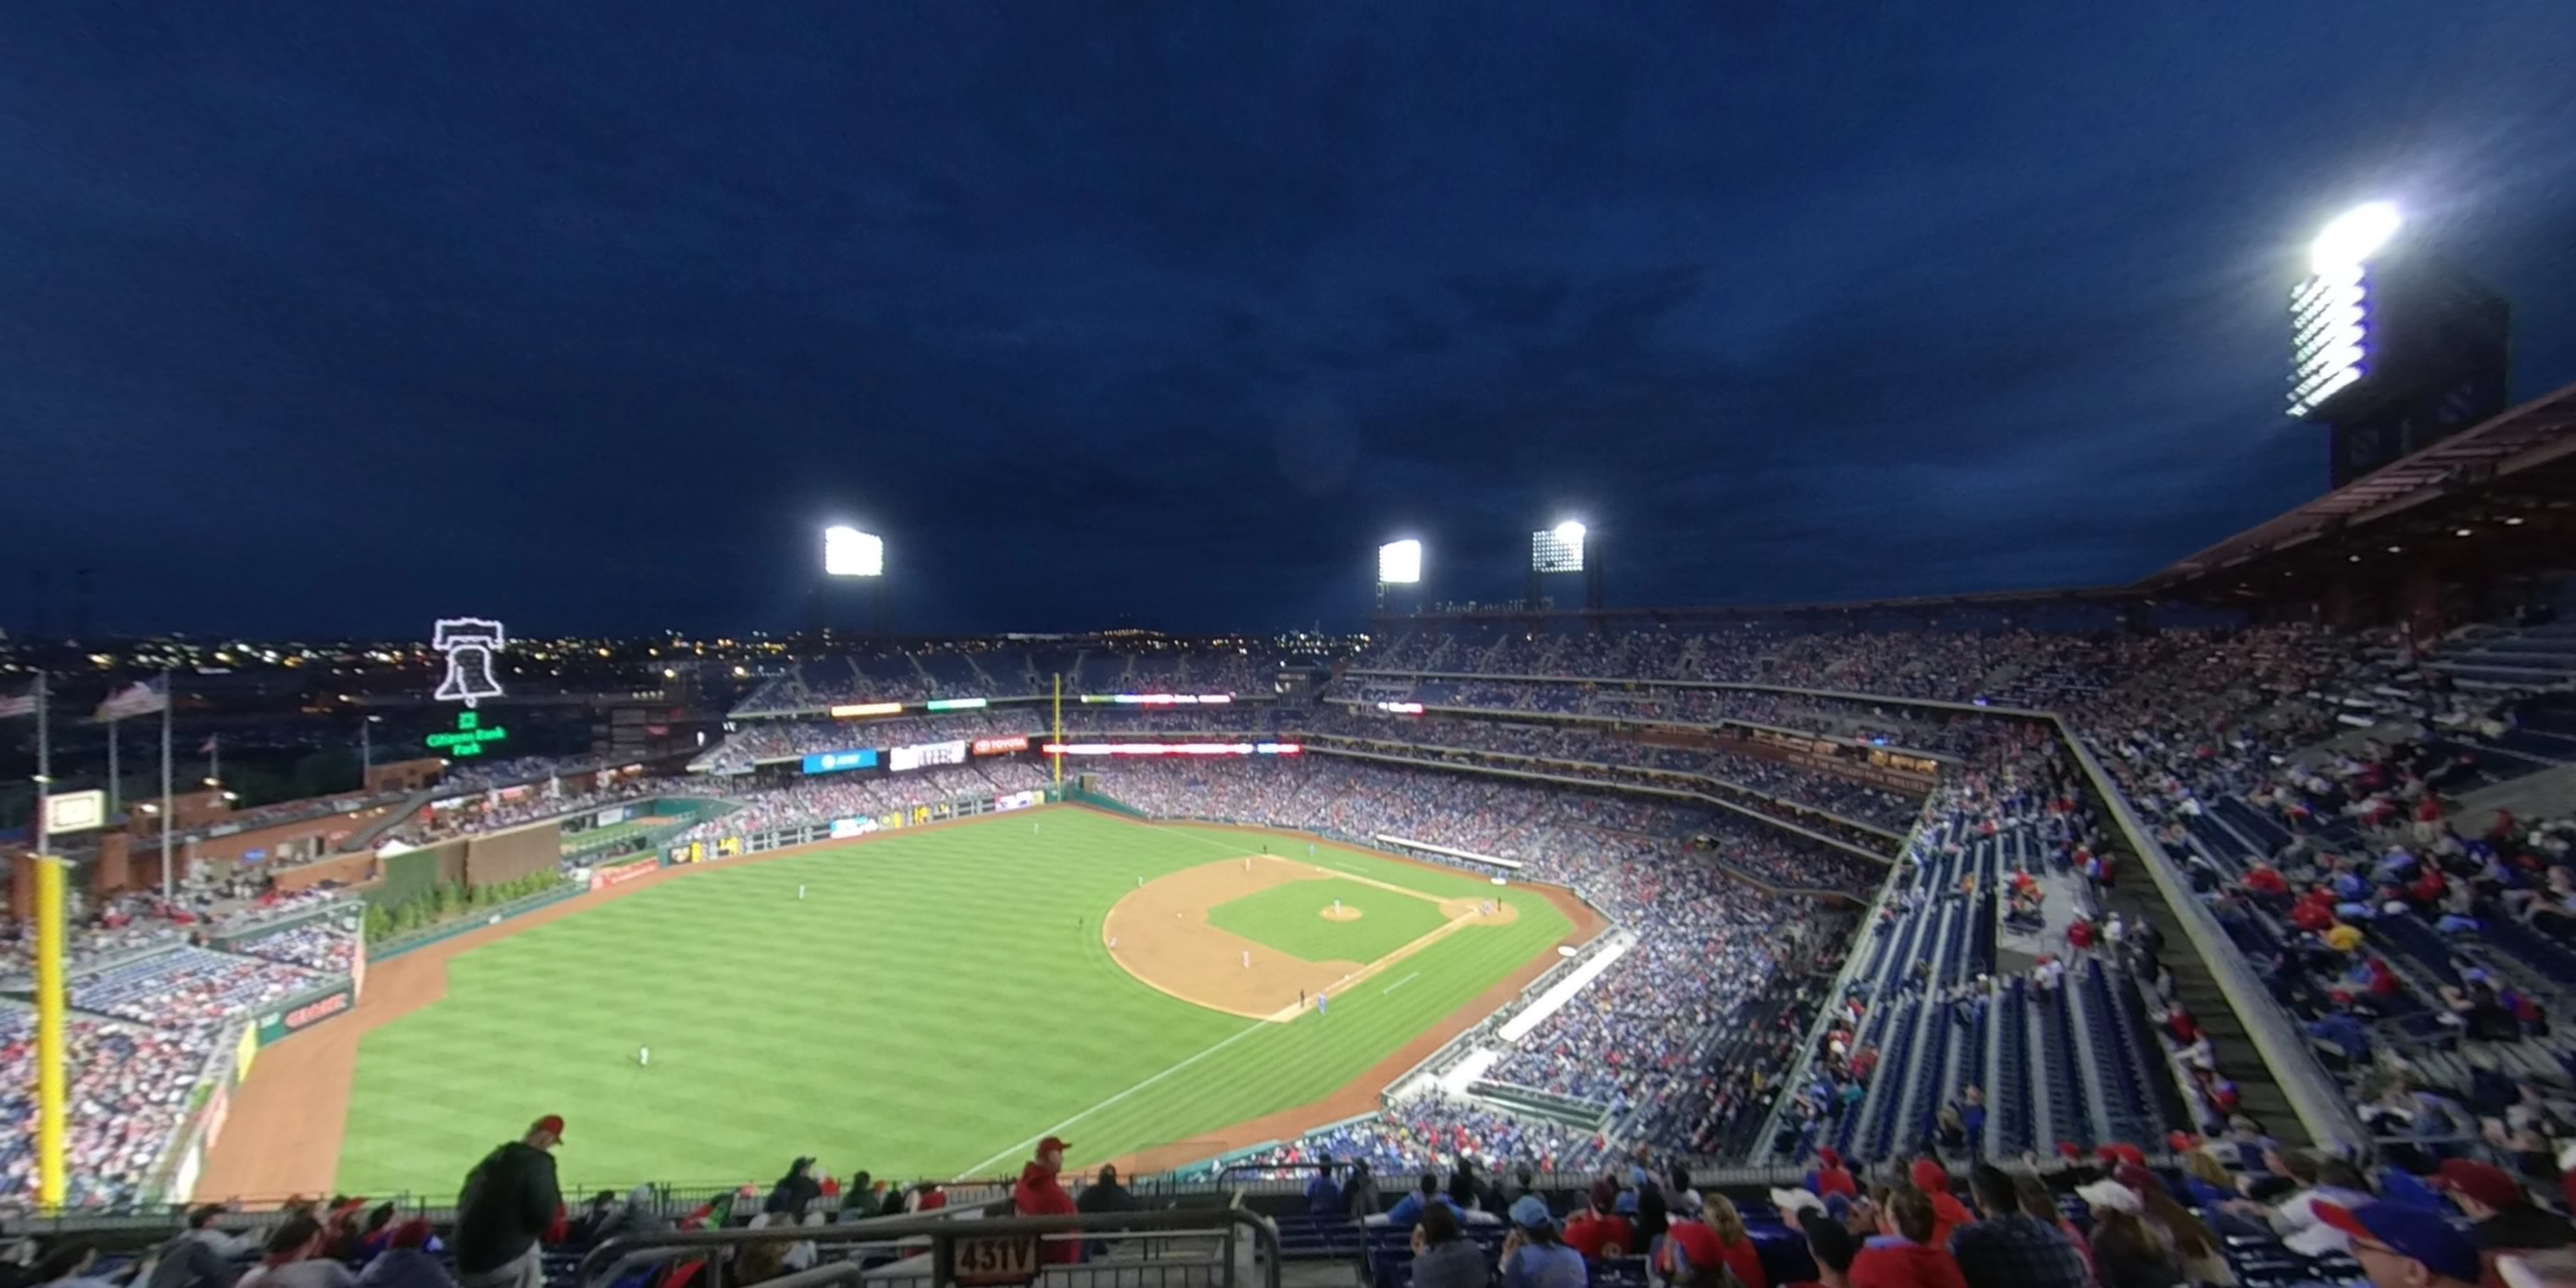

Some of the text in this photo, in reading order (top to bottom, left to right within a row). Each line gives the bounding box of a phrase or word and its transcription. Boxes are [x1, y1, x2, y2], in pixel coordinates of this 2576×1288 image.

[427, 727, 505, 747] Citizens Bank
[990, 737, 1026, 748] TOYOTA
[453, 742, 480, 756] Park
[961, 1239, 1030, 1270] 431V
